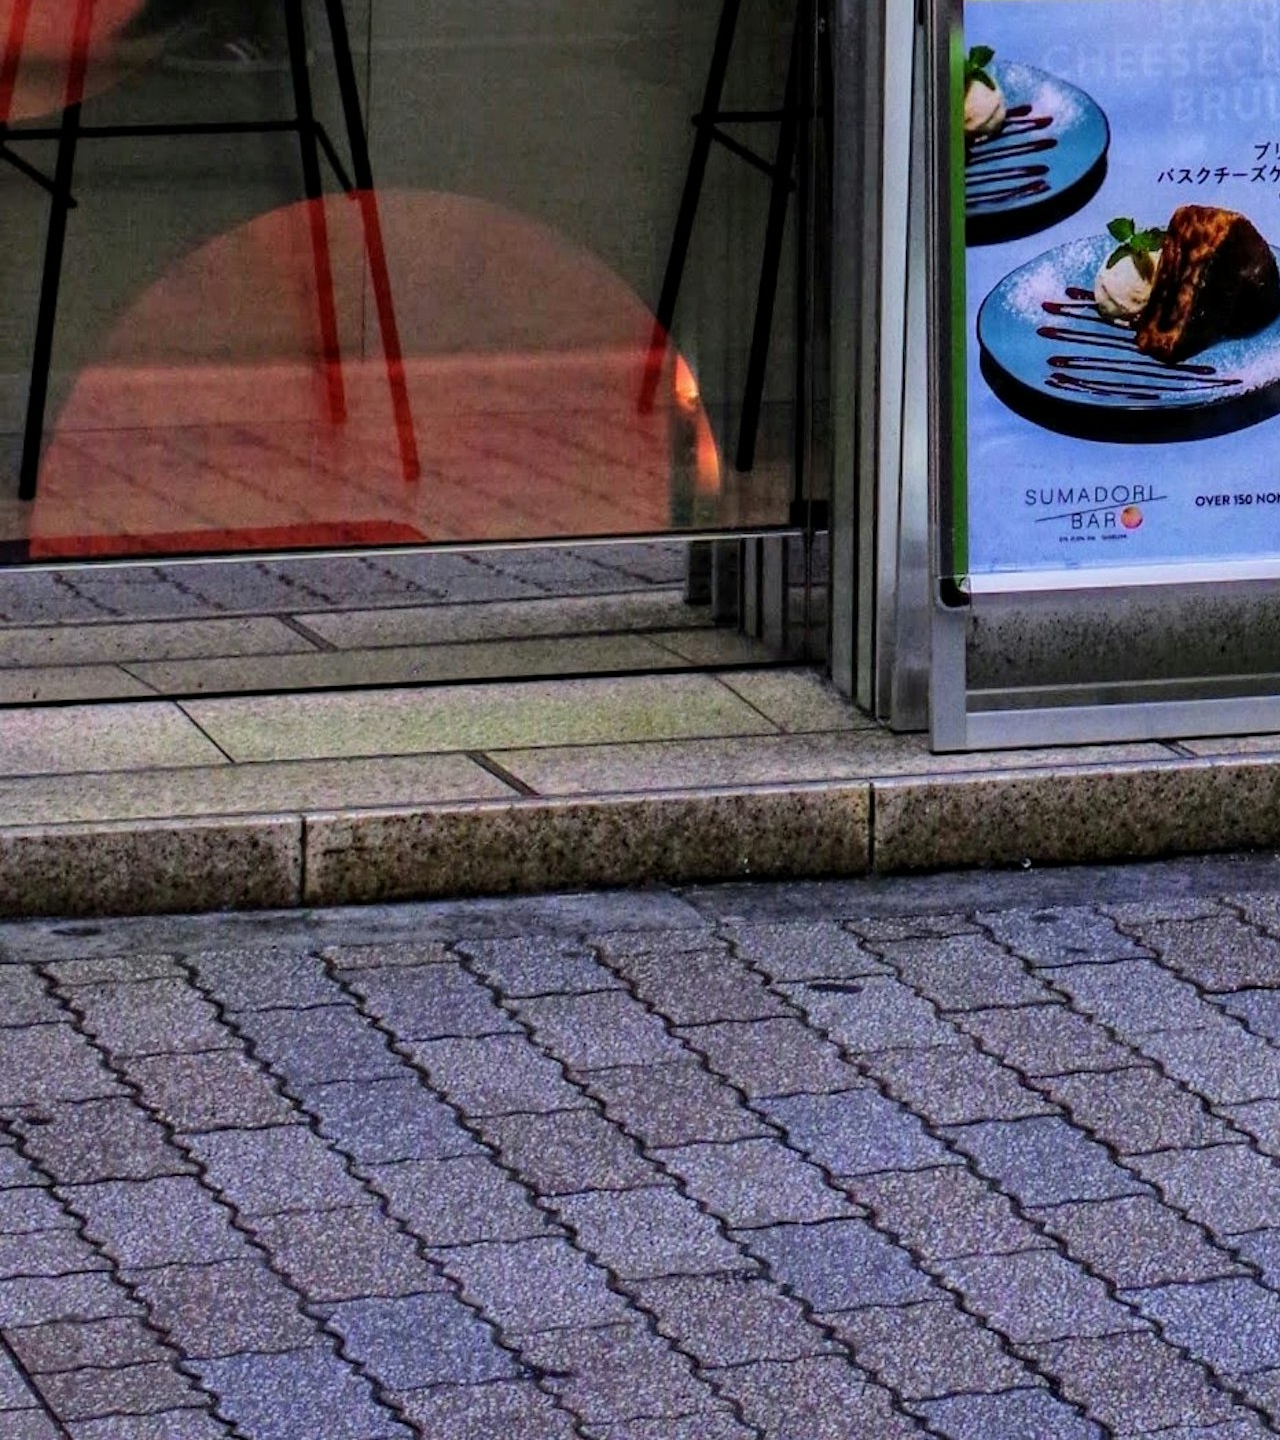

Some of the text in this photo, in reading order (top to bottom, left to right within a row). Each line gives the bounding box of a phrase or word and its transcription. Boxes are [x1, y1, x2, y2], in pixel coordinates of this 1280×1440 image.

[1025, 485, 1156, 506] SUMADORI
[1195, 495, 1230, 506] OVER
[1234, 494, 1252, 505] 150
[1071, 512, 1116, 529] BAR
